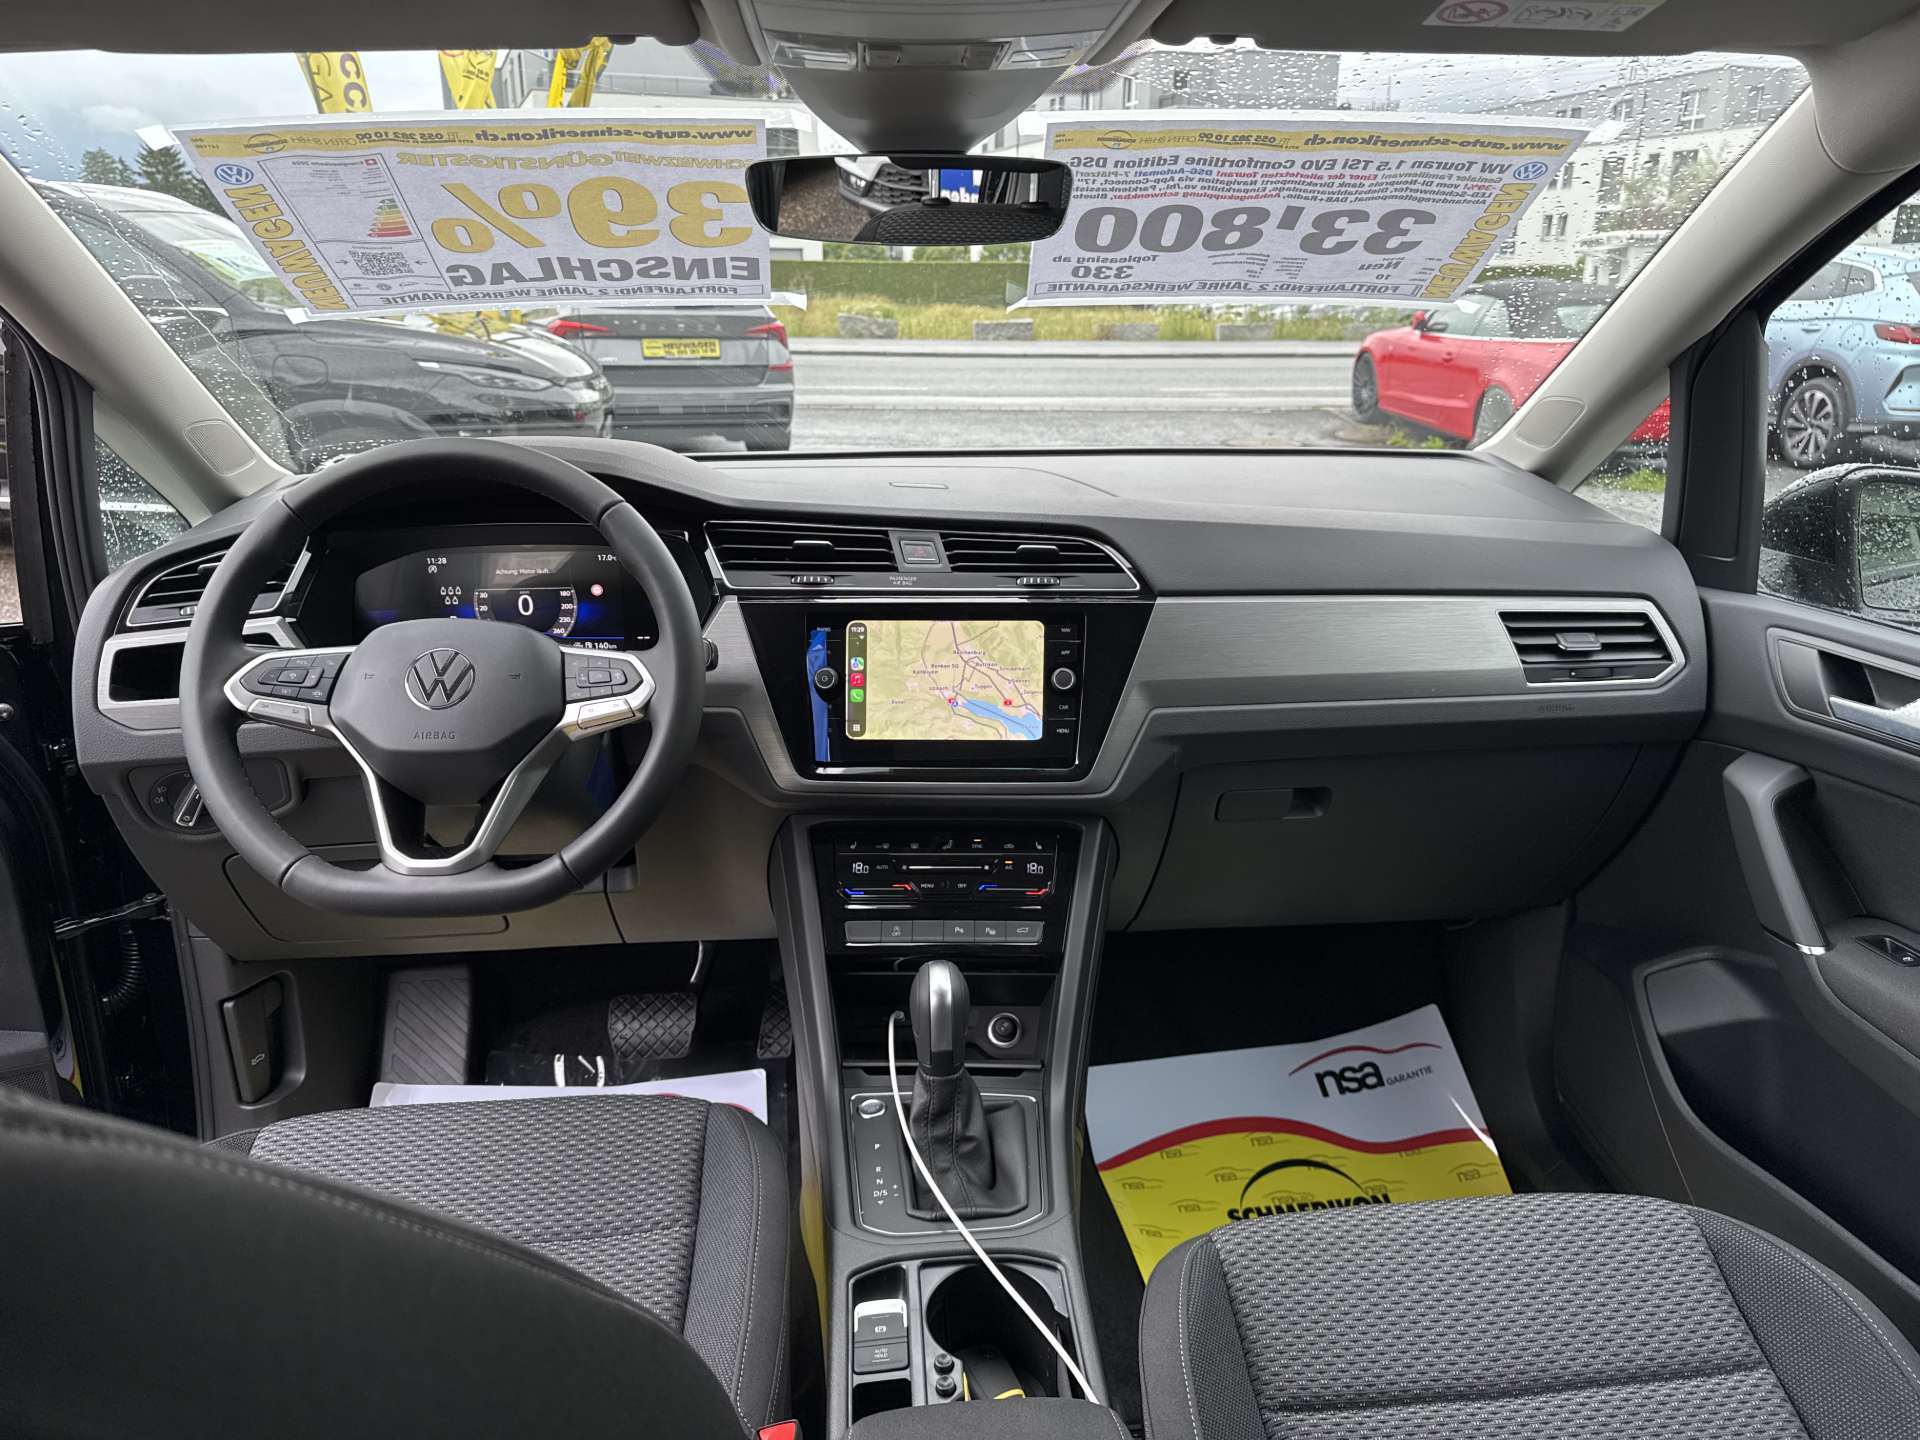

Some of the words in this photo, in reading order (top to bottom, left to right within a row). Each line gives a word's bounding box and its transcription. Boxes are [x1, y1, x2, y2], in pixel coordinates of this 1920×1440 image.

[426, 557, 447, 565] 11:28
[518, 594, 534, 616] 0
[414, 730, 457, 741] AIRBAG
[1314, 1061, 1386, 1098] nsa
[1386, 1065, 1434, 1086] GARANTIE
